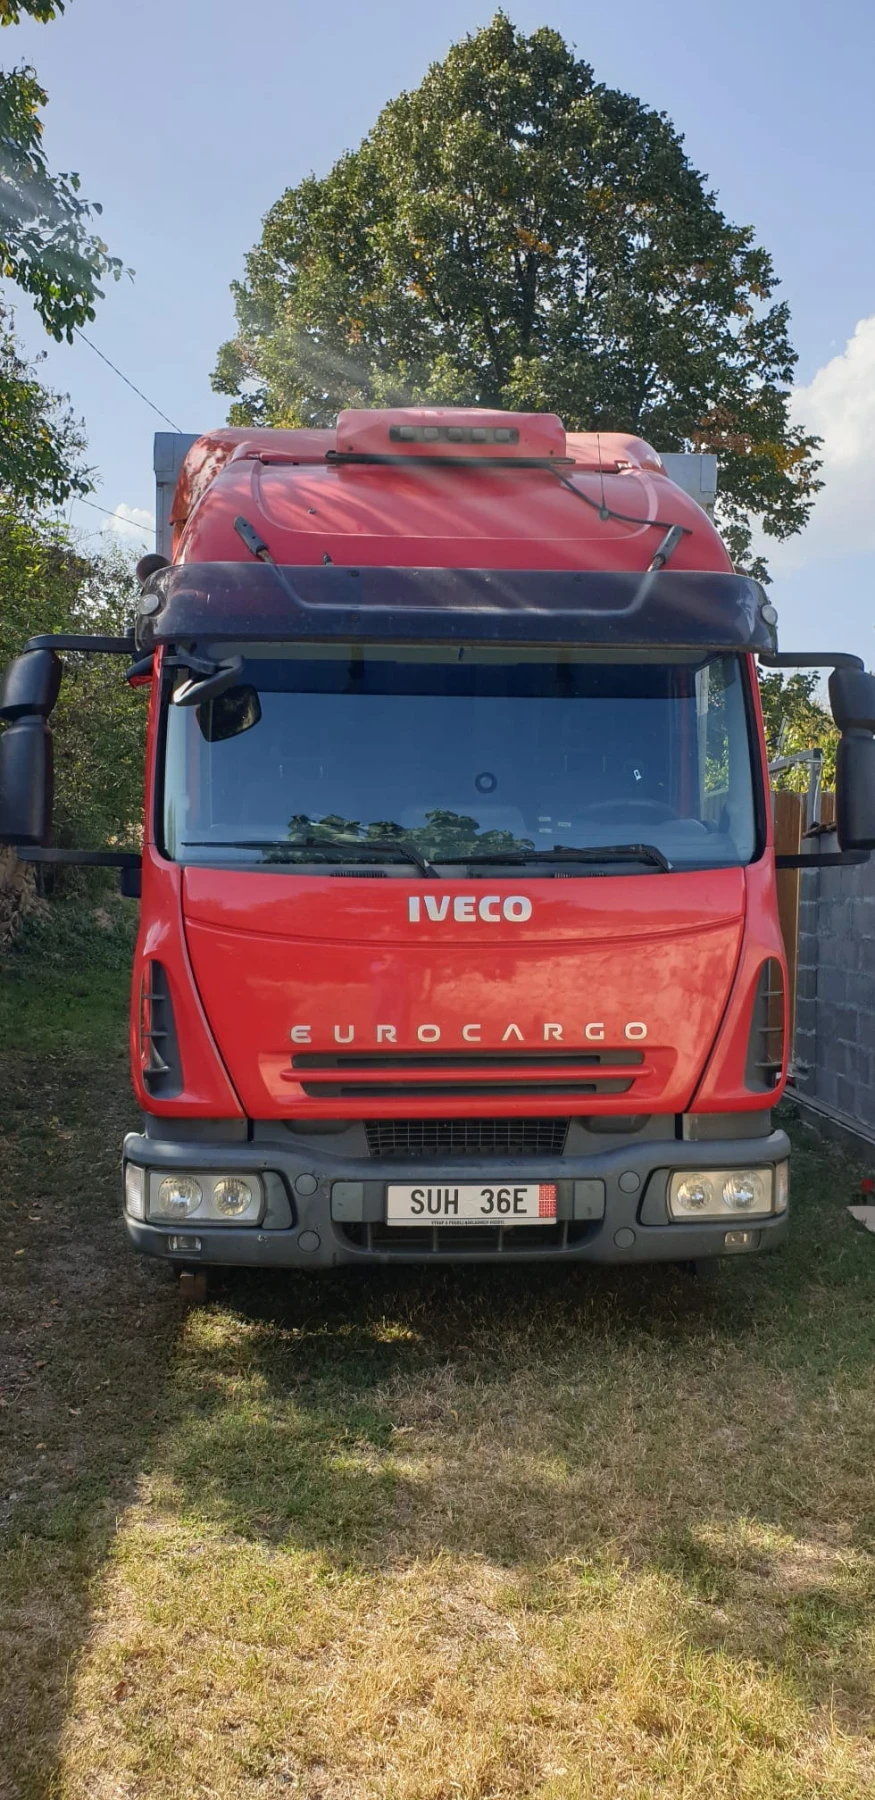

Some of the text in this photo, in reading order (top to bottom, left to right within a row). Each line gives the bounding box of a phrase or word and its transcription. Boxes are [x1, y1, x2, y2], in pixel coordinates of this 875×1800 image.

[408, 895, 533, 922] IVECO
[290, 1021, 649, 1044] EUROCARGO
[410, 1188, 528, 1215] SUH 36E
